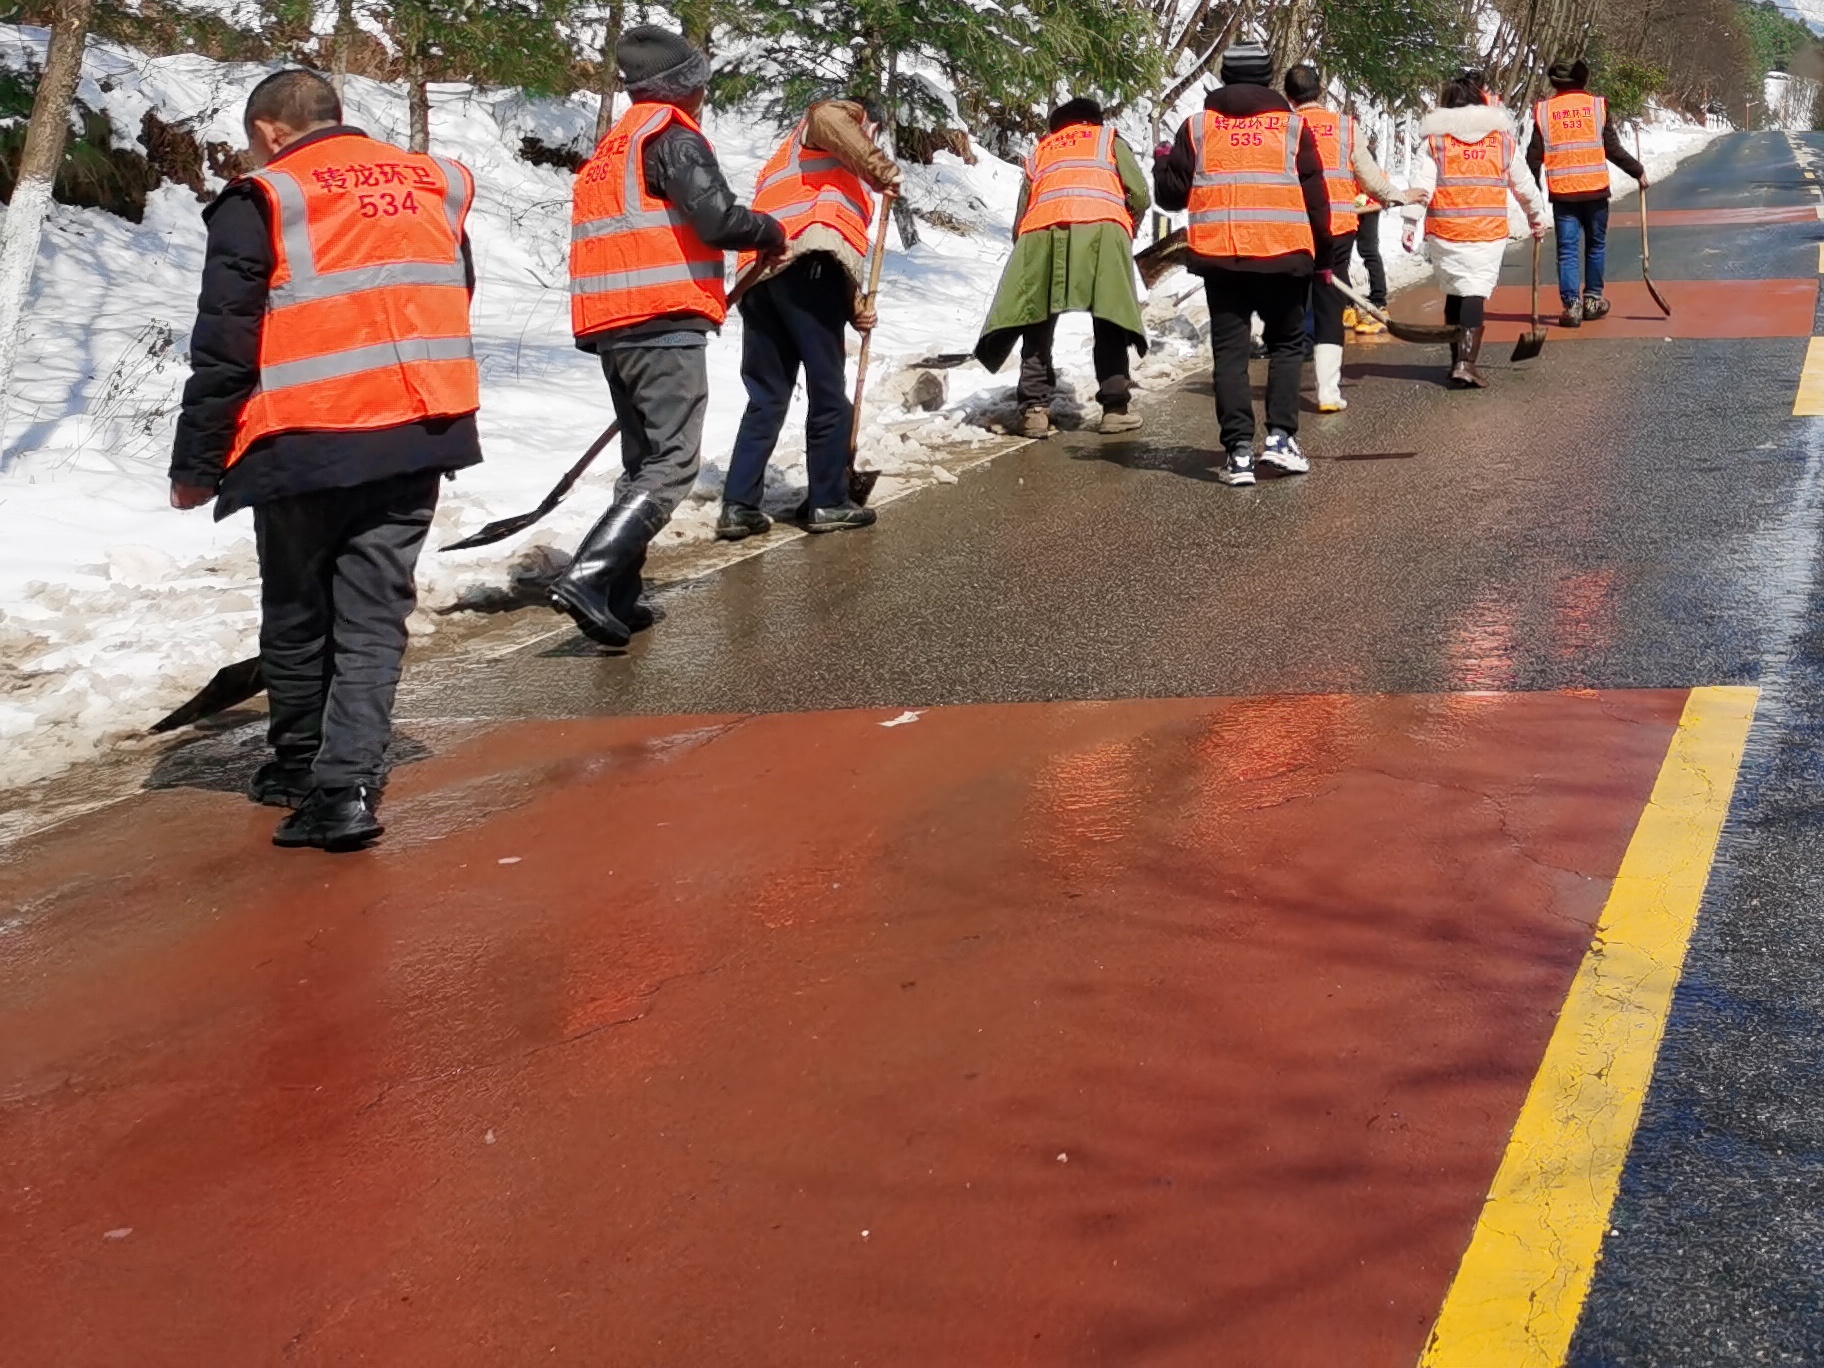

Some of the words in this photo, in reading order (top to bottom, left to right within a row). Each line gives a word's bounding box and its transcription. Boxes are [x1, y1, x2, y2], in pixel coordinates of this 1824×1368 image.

[1215, 115, 1280, 130] 转龙环卫
[1230, 133, 1263, 147] 535
[1463, 149, 1487, 160] 507
[312, 163, 436, 193] 转龙环卫
[358, 190, 419, 218] 534
